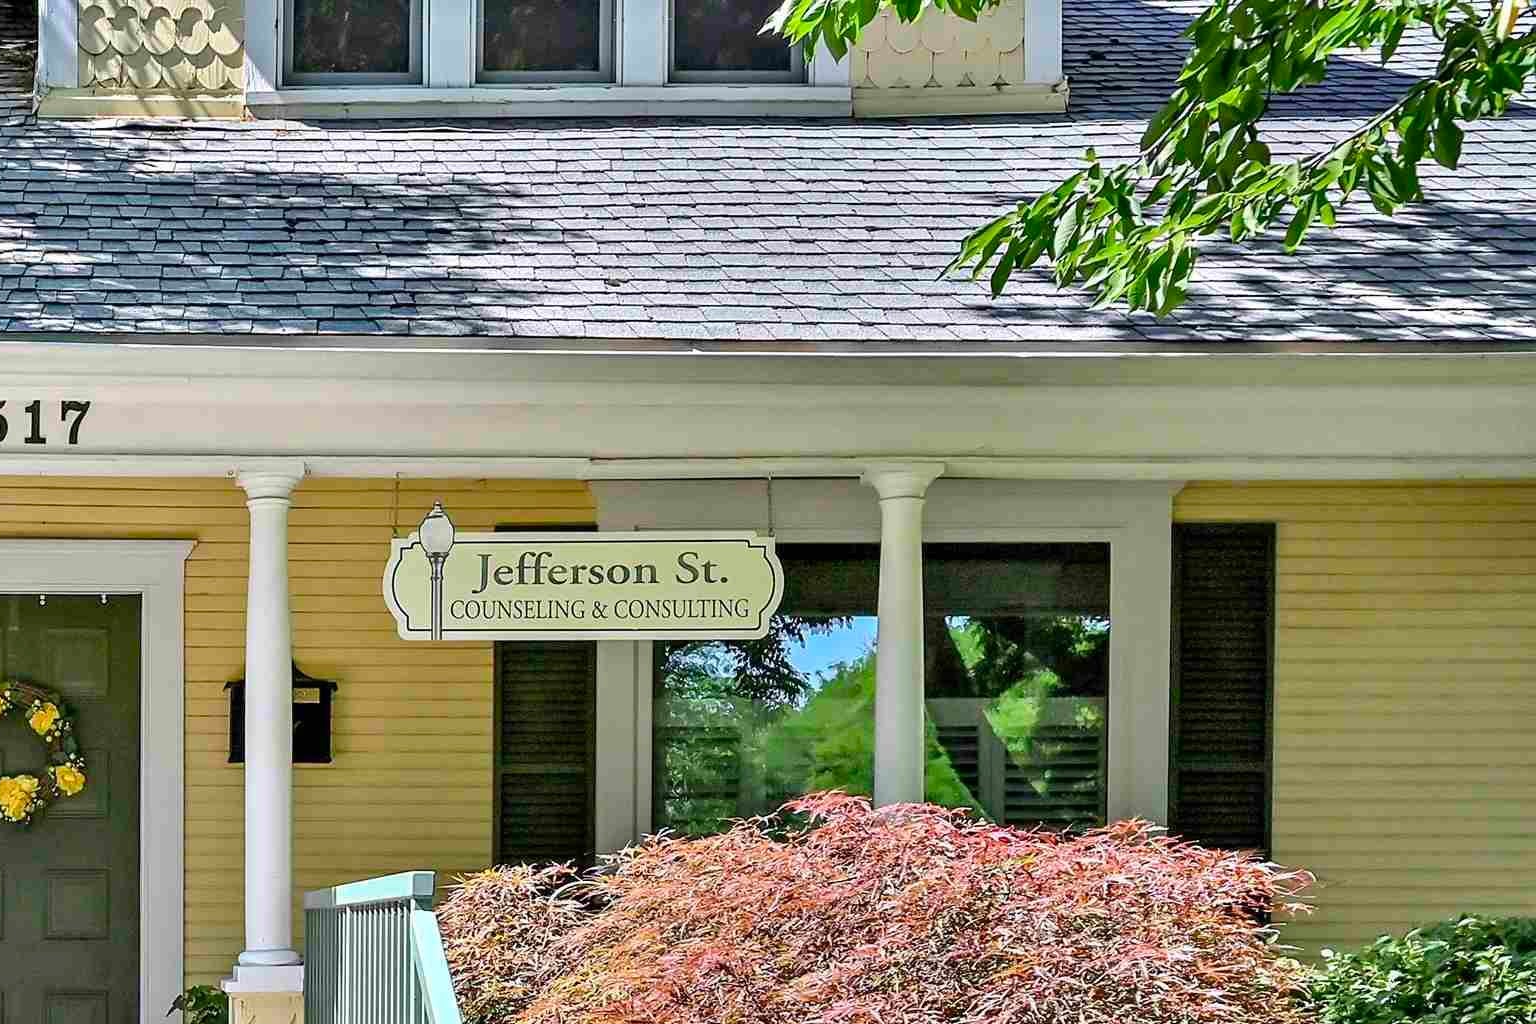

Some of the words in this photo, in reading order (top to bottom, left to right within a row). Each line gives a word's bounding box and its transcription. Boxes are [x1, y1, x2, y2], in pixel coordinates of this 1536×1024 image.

[472, 551, 658, 594] Jefferson
[675, 551, 729, 585] St.
[450, 600, 585, 620] COUNSELING
[593, 600, 609, 619] &
[614, 598, 750, 619] CONSULTING
